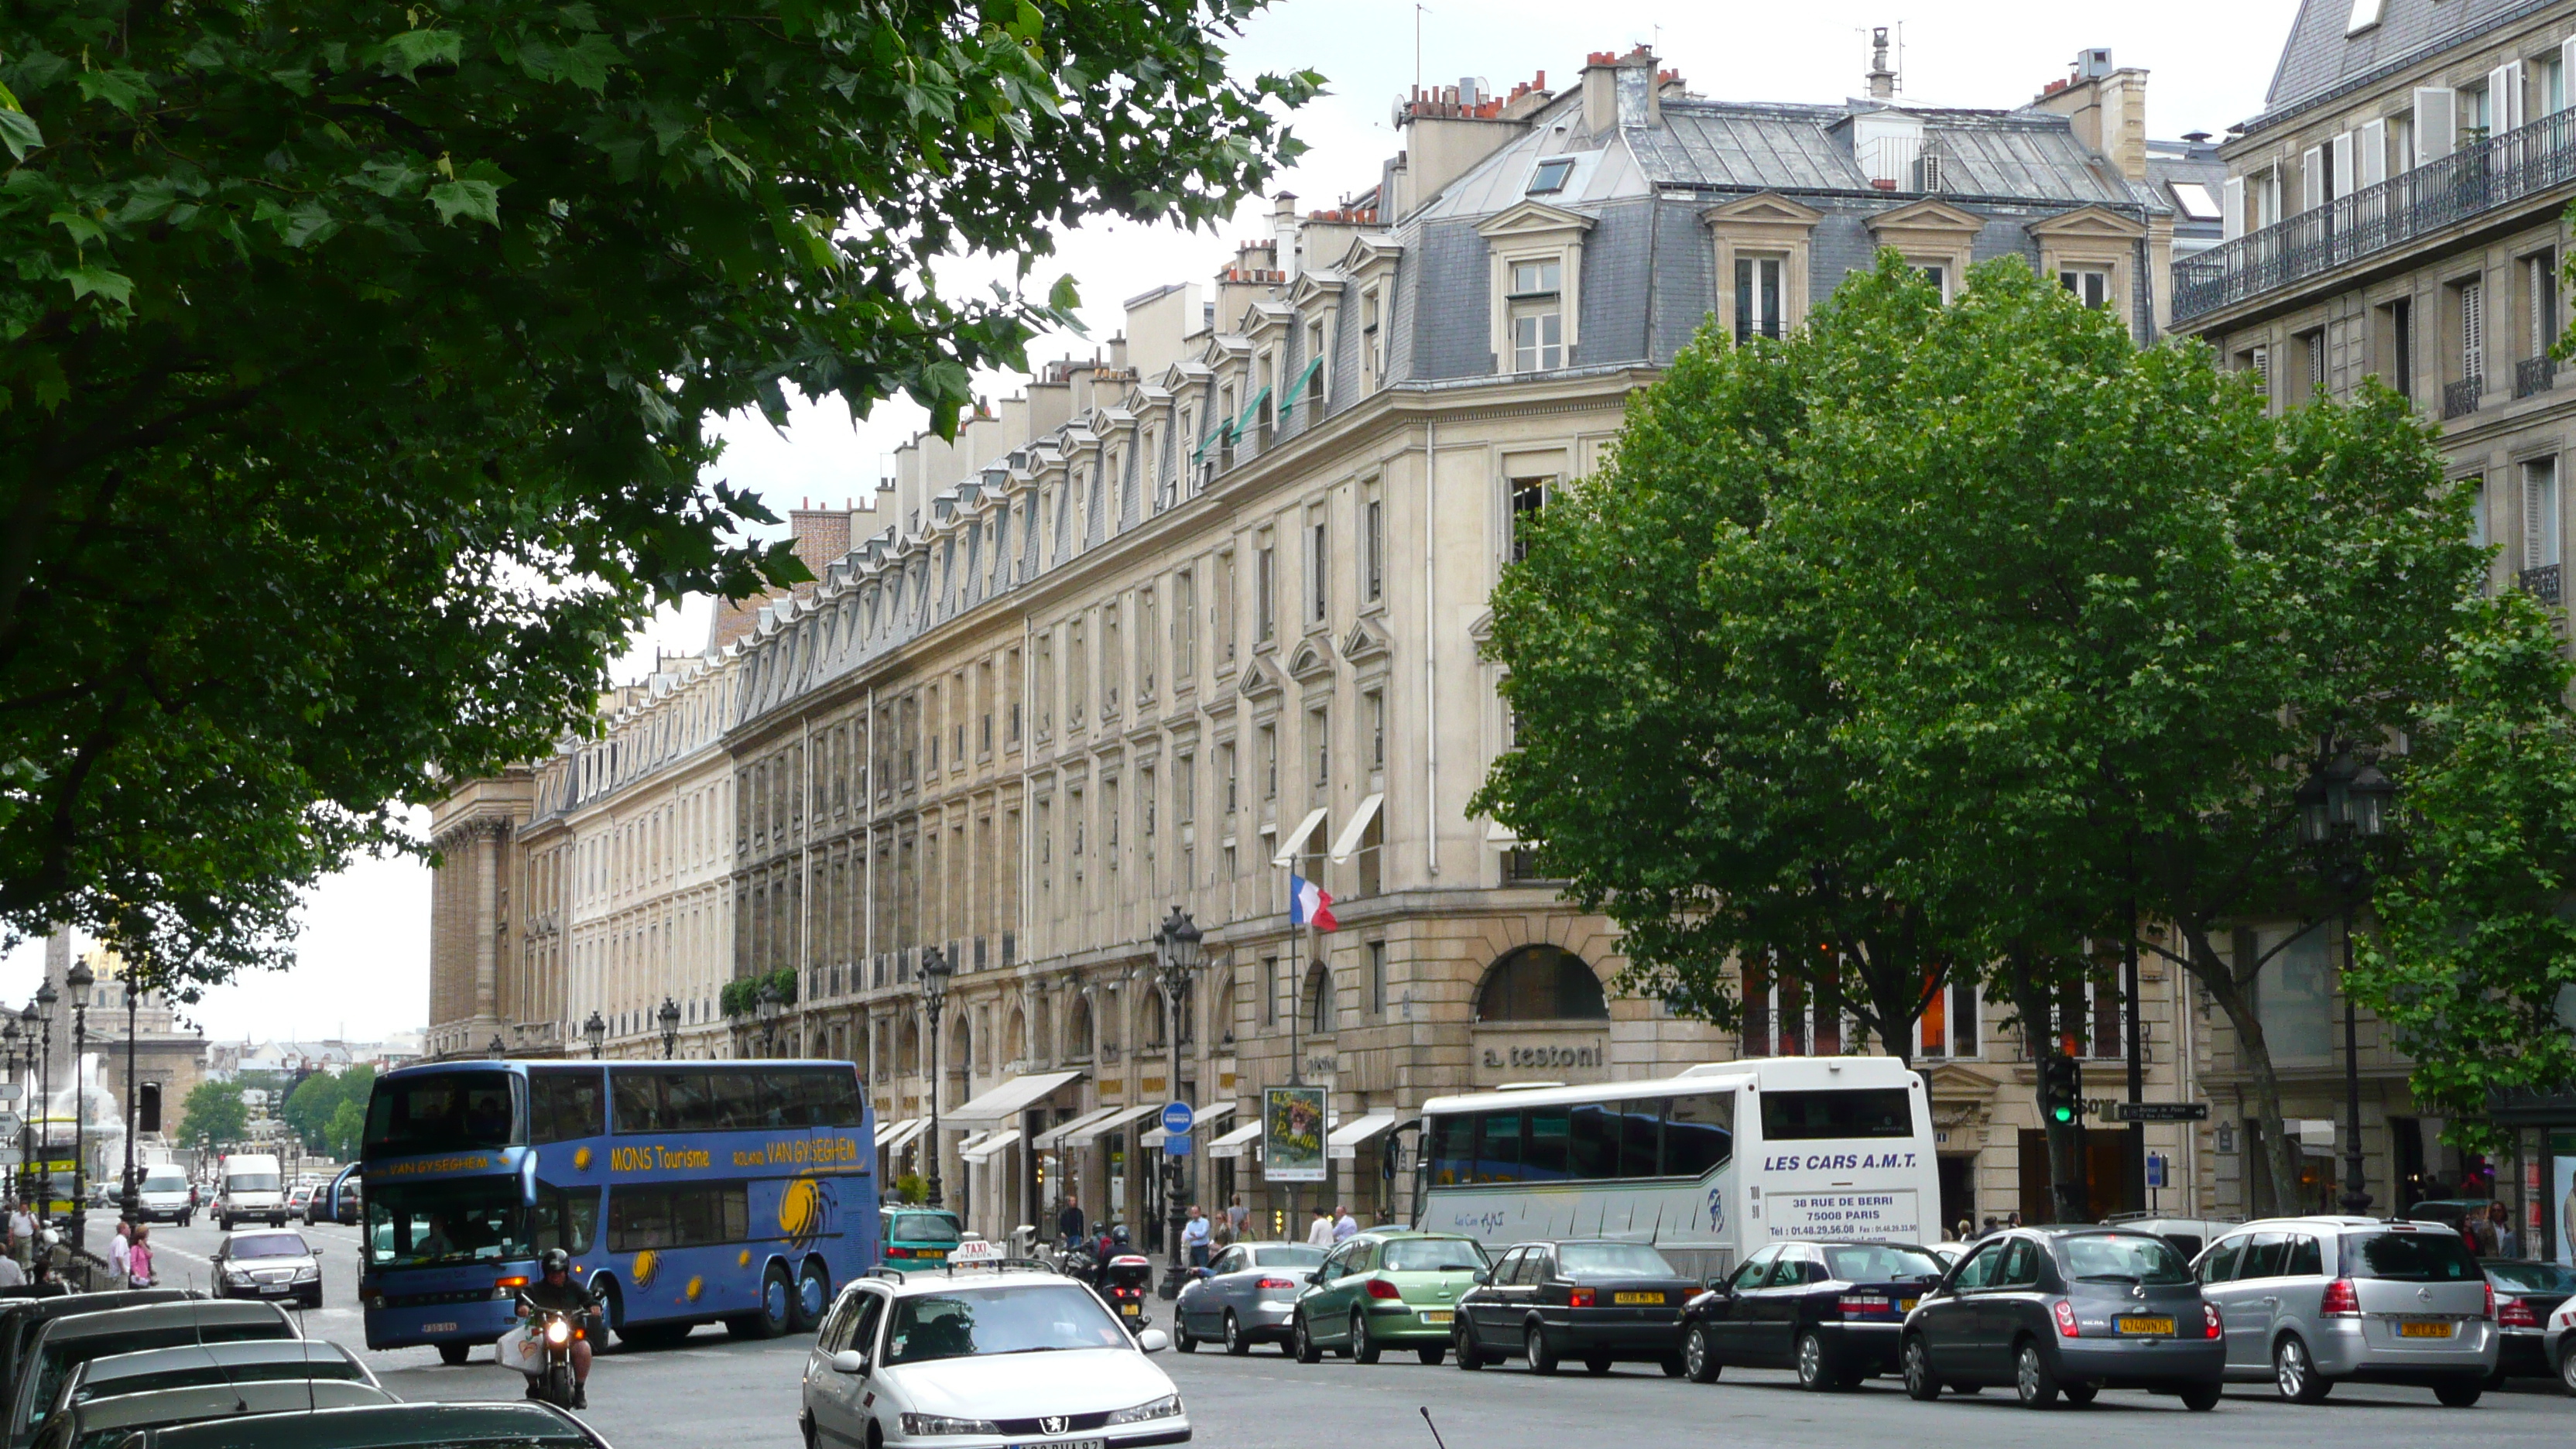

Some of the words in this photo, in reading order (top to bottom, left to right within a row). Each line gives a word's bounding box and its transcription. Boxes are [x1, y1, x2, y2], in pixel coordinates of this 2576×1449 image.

[1510, 1037, 1602, 1067] testoni
[611, 1146, 653, 1171] MONS
[655, 1145, 710, 1169] Tourisme
[733, 1151, 764, 1166] ROLAND
[766, 1141, 793, 1163] VAN
[794, 1137, 857, 1163] GYSEGHEM
[390, 1163, 415, 1175] VAN
[418, 1156, 488, 1173] GYSEGHEM
[1763, 1156, 1800, 1171] LES
[1806, 1154, 1858, 1170] CARS
[1862, 1153, 1917, 1169] A.M.T.
[1793, 1199, 1807, 1208] 38
[1810, 1198, 1835, 1208] RUE
[1838, 1197, 1854, 1207] DE
[1858, 1197, 1893, 1206] BERRI
[1806, 1211, 1842, 1221] 75008
[1845, 1211, 1880, 1220] PARIS
[1769, 1227, 1783, 1236] Tél
[964, 1242, 987, 1253] TAXI
